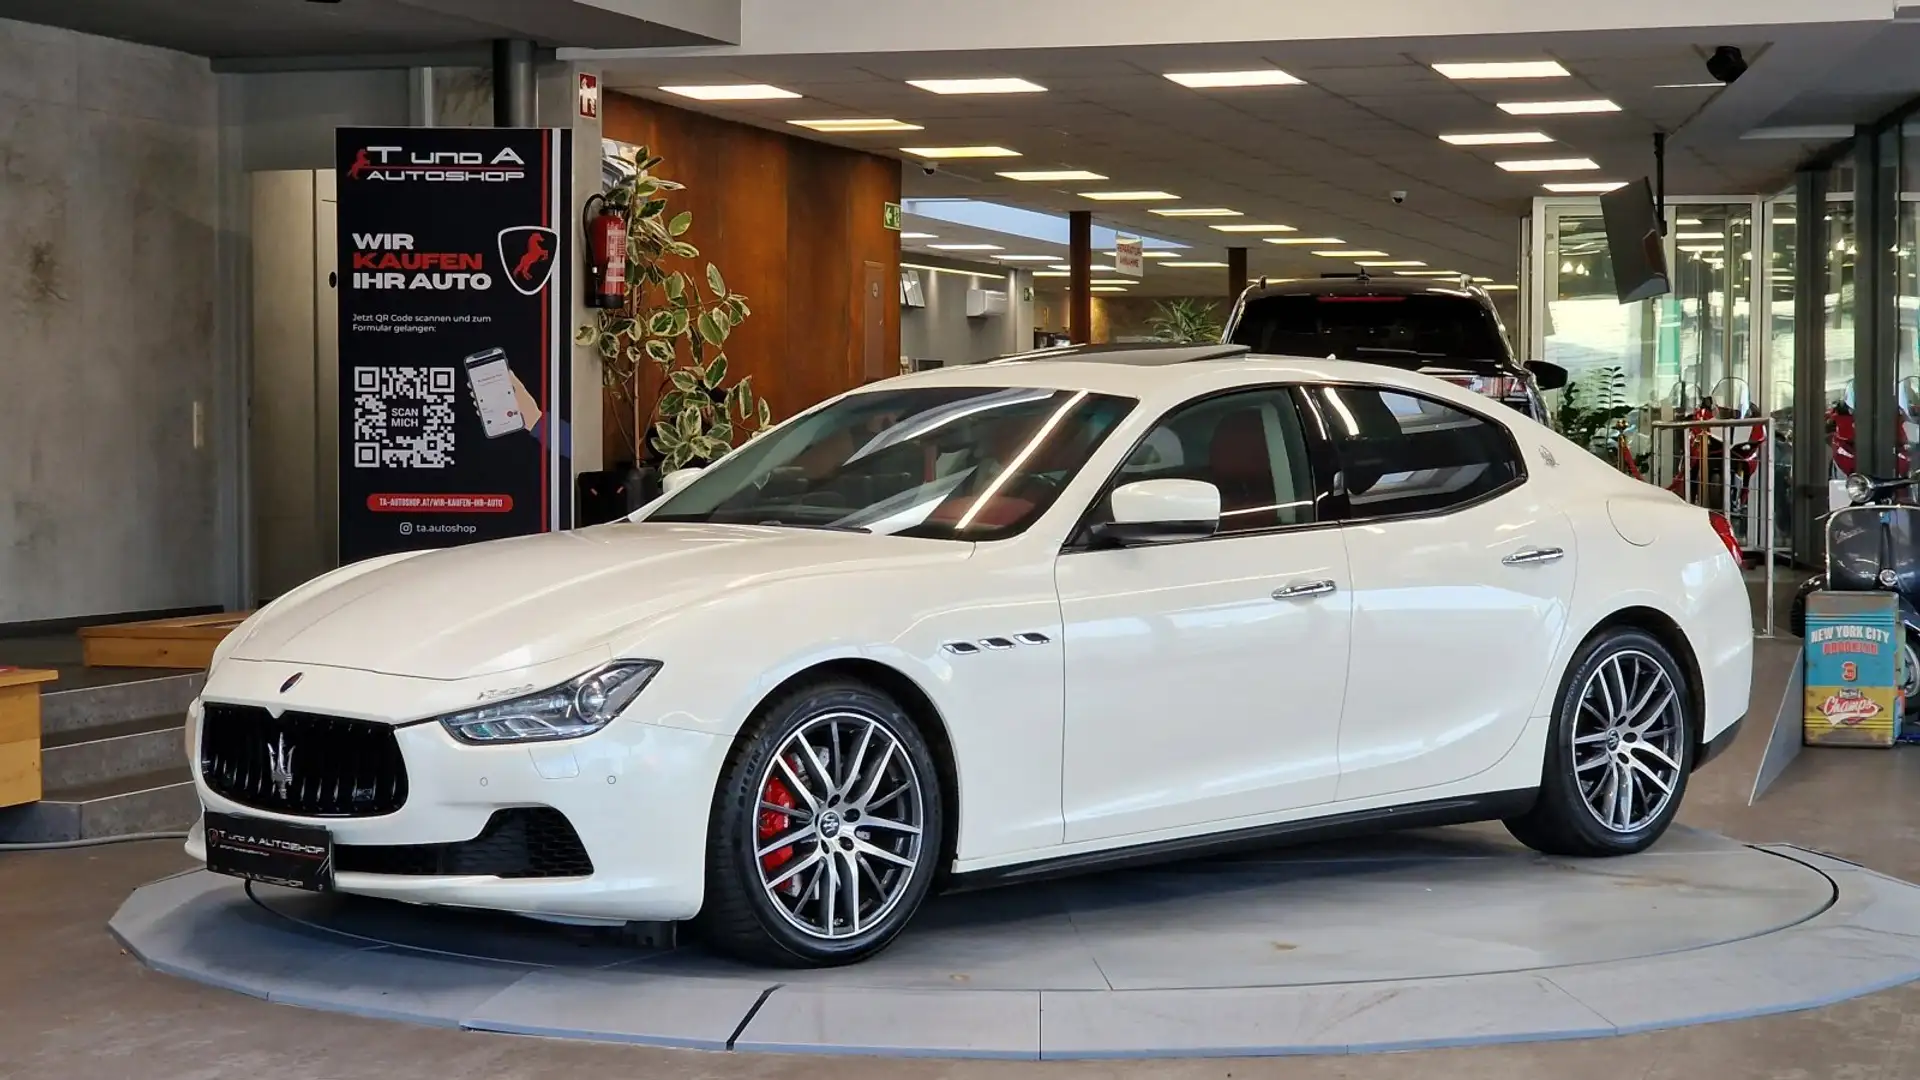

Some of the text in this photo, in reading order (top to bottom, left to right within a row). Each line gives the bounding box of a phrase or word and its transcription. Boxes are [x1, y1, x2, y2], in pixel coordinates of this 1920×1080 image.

[367, 146, 402, 164] T
[490, 147, 525, 165] A
[366, 170, 525, 182] AUTOSHOP
[352, 233, 414, 250] WIR
[353, 253, 482, 270] KAUFEN
[353, 272, 492, 290] IHR AUTO
[352, 314, 492, 324] Jetzt QR Code scannen und zum
[352, 324, 437, 334] Formular gelangen:
[391, 408, 419, 417] SCAN
[391, 418, 419, 427] MICH
[416, 523, 477, 534] ta.autoshop
[1811, 625, 1890, 644] NEW YORK CITY
[1842, 661, 1857, 682] 3
[1824, 695, 1878, 716] Champs
[258, 838, 325, 854] AUTOSHOP
